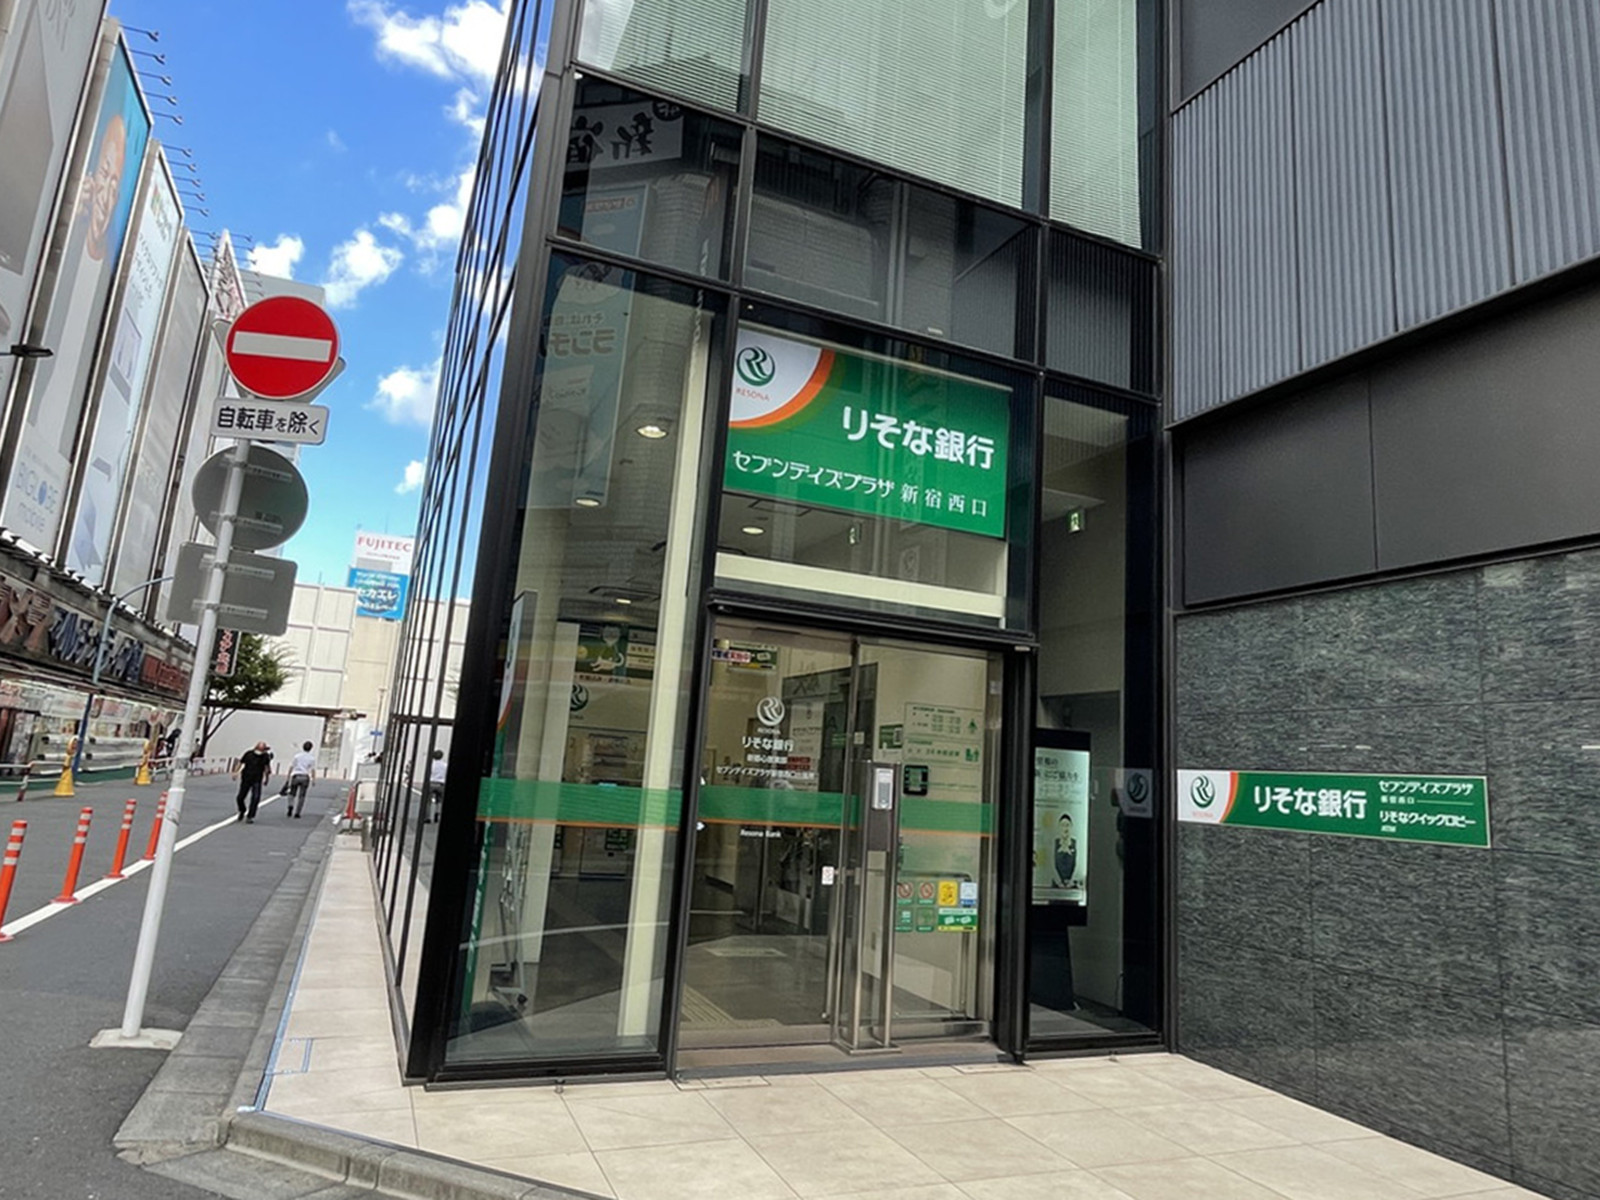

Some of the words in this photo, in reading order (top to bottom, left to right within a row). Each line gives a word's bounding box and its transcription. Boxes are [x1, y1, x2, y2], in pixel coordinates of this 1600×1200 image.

[217, 406, 321, 436] 自転車を除く
[842, 405, 995, 470] りそな銀行
[732, 450, 895, 499] セブンデイズプラザ
[900, 482, 988, 517] 新宿西口
[357, 535, 412, 553] FUJITEC
[741, 736, 795, 753] りそな銀行
[1253, 785, 1368, 820] りそな銀行
[1379, 810, 1477, 828] りそなクイックロビー
